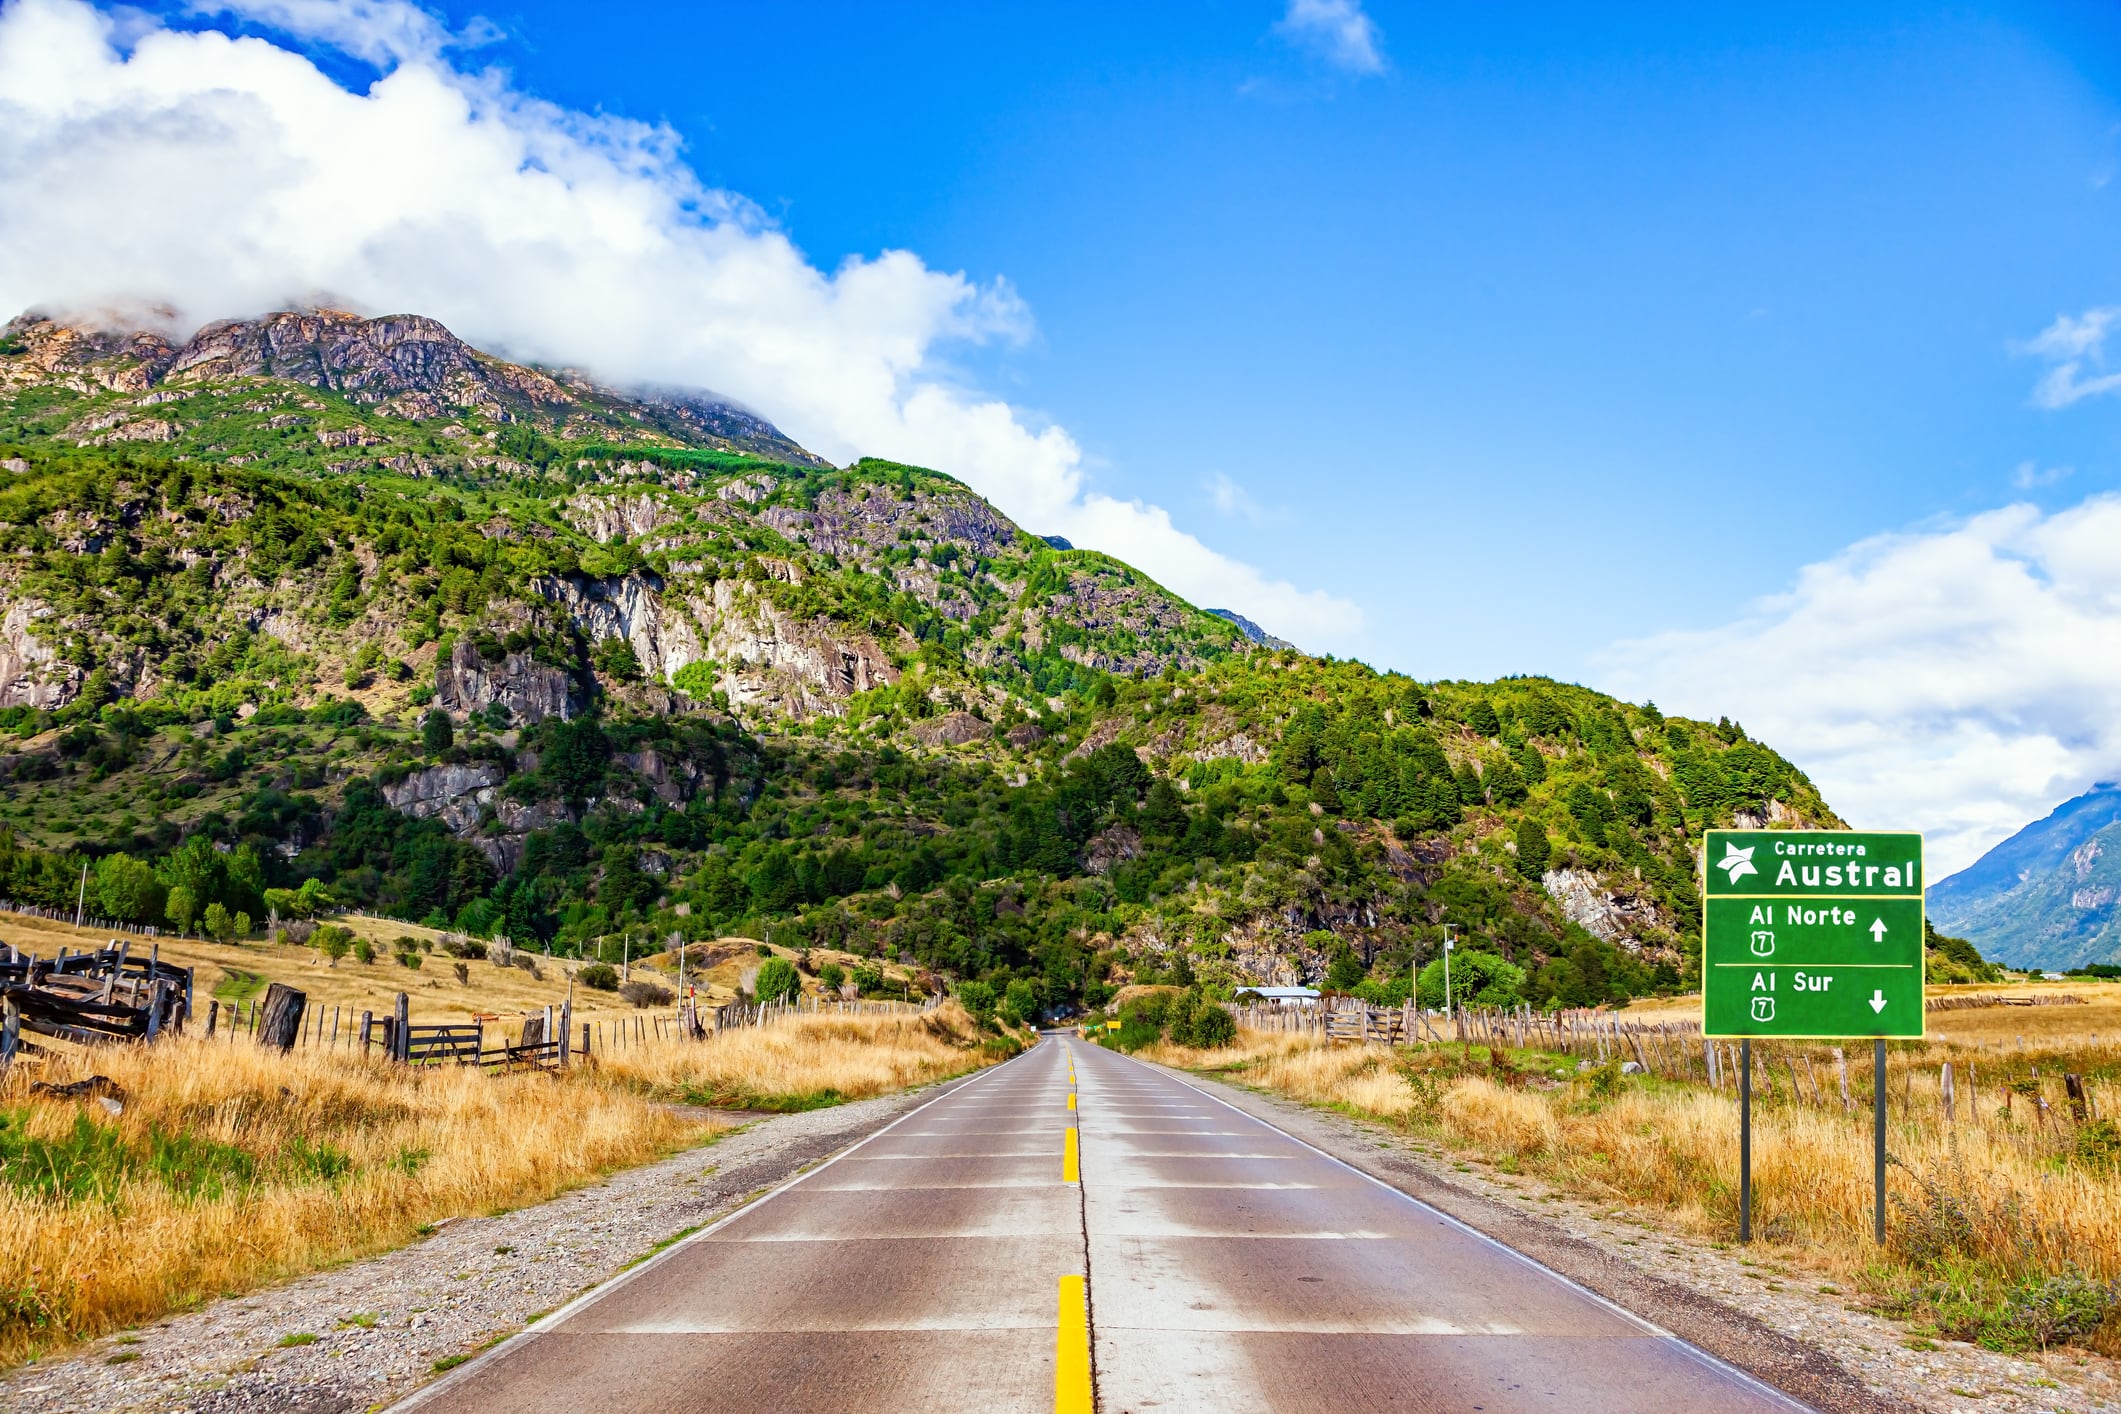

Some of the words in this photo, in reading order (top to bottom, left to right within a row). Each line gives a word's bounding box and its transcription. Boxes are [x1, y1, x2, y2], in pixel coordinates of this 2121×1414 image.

[1774, 841, 1867, 857] Carretera
[1775, 860, 1914, 888] Austral
[1749, 905, 1773, 925] Al
[1787, 906, 1857, 926] Norte
[1757, 935, 1767, 952] 7
[1750, 972, 1776, 992] Al
[1793, 972, 1834, 992] Sur
[1758, 1001, 1767, 1017] 7
